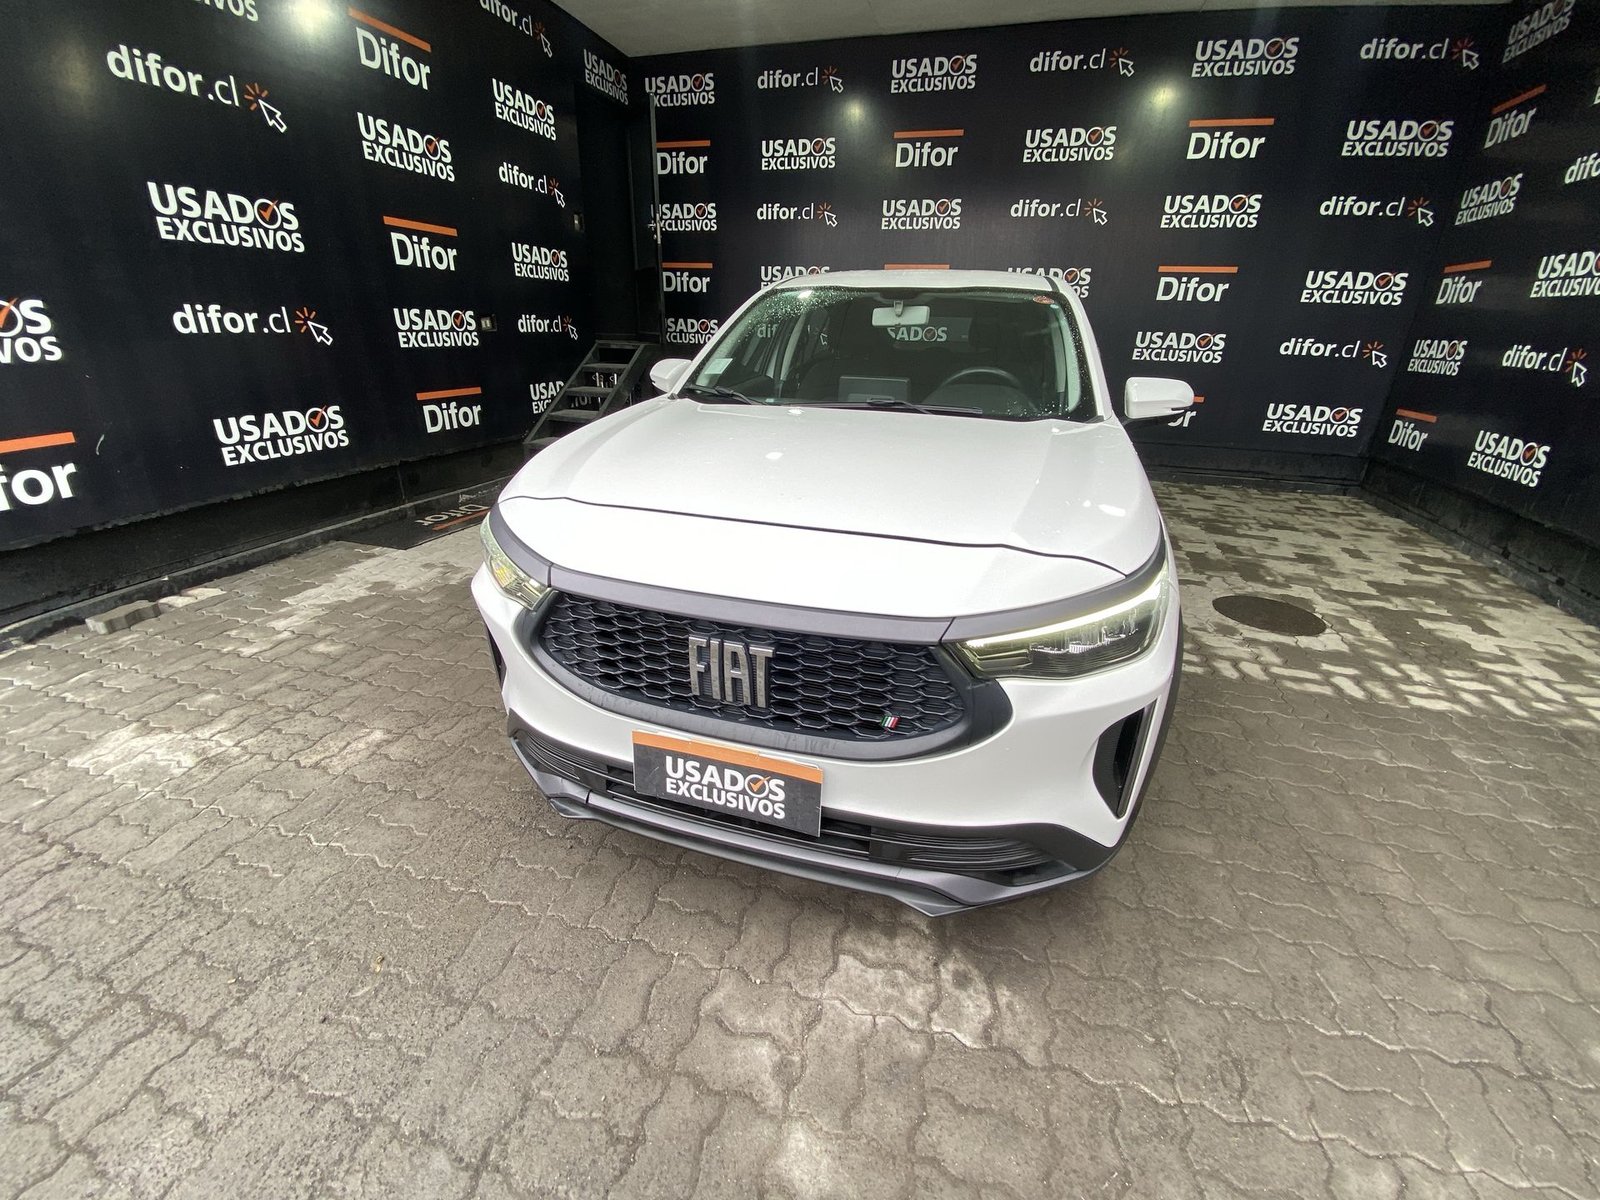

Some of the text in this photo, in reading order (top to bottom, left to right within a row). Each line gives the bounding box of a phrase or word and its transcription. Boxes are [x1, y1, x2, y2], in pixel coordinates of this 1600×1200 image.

[355, 27, 431, 90] Difor
[1029, 48, 1106, 73] difor.cl
[1195, 37, 1299, 61] USADOS
[1360, 38, 1449, 60] difor.cl
[107, 45, 240, 107] difor.cl
[583, 49, 627, 92] USADOS
[757, 67, 818, 89] difor.cl
[891, 54, 977, 78] USADOS
[1191, 59, 1296, 78] EXCLUSIVOS
[585, 68, 629, 105] EXCLUSIVOS
[645, 73, 715, 93] USADOS
[890, 74, 976, 93] EXCLUSIVOS
[492, 78, 555, 126] USADOS
[654, 91, 716, 107] XCLUSIVOS
[495, 102, 556, 141] EXCLUSIVOS
[1346, 120, 1454, 142] USADOS
[1484, 108, 1537, 149] Difor
[357, 112, 452, 164] USADOS
[761, 137, 836, 157] USADOS
[1025, 126, 1117, 147] USADOS
[1186, 131, 1265, 160] Difor
[362, 140, 455, 182] EXCLUSIVOS
[895, 142, 958, 167] Difor
[1022, 146, 1114, 163] EXCLUSIVOS
[1341, 141, 1449, 158] EXCLUSIVOS
[656, 152, 708, 174] Difor
[761, 155, 836, 170] EXCLUSIVOS
[498, 162, 548, 194] difor.cl
[1460, 173, 1523, 210] USADOS
[147, 181, 299, 230] USADOS
[756, 203, 814, 220] difor.cl
[882, 199, 961, 218] USADOS
[1010, 198, 1081, 217] difor.cl
[1164, 194, 1262, 215] USADOS
[1319, 197, 1405, 217] difor.cl
[1454, 197, 1516, 226] EXCLUSIVOS
[881, 216, 961, 230] EXCLUSIVOS
[1160, 213, 1258, 229] EXCLUSIVOS
[155, 217, 305, 253] EXCLUSIVOS
[390, 232, 457, 271] Difor
[511, 242, 567, 269] USADOS
[514, 262, 569, 282] EXCLUSIVOS
[662, 272, 710, 292] Difor
[1305, 271, 1408, 292] USADOS
[1156, 276, 1230, 302] Difor
[1300, 289, 1403, 306] EXCLUSIVOS
[1435, 275, 1482, 305] Difor
[173, 304, 291, 334] difor.cl
[393, 307, 476, 332] USADOS
[518, 314, 562, 333] difor.cl
[665, 317, 719, 334] SADOS
[398, 329, 479, 348] EXCLUSIVOS
[1135, 332, 1226, 351] USADOS
[1279, 338, 1360, 358] difor.cl
[1412, 339, 1467, 361] USADOS
[1132, 349, 1223, 363] EXCLUSIVOS
[1407, 358, 1460, 376] EXCLUSIVOS
[1502, 345, 1567, 372] difor.cl
[213, 405, 344, 445] USADOS
[423, 402, 481, 433] Difor
[1267, 403, 1363, 425] USADOS
[1262, 420, 1358, 437] EXCLUSIVOS
[1387, 419, 1428, 452] Difor
[221, 429, 349, 466] EXCLUSIVOS
[1474, 430, 1551, 469] USADOS
[1467, 452, 1542, 488] EXCLUSIVOS
[689, 635, 775, 709] FIAT
[665, 755, 785, 802] USADOS
[666, 777, 785, 820] EXCLUSIVOS
